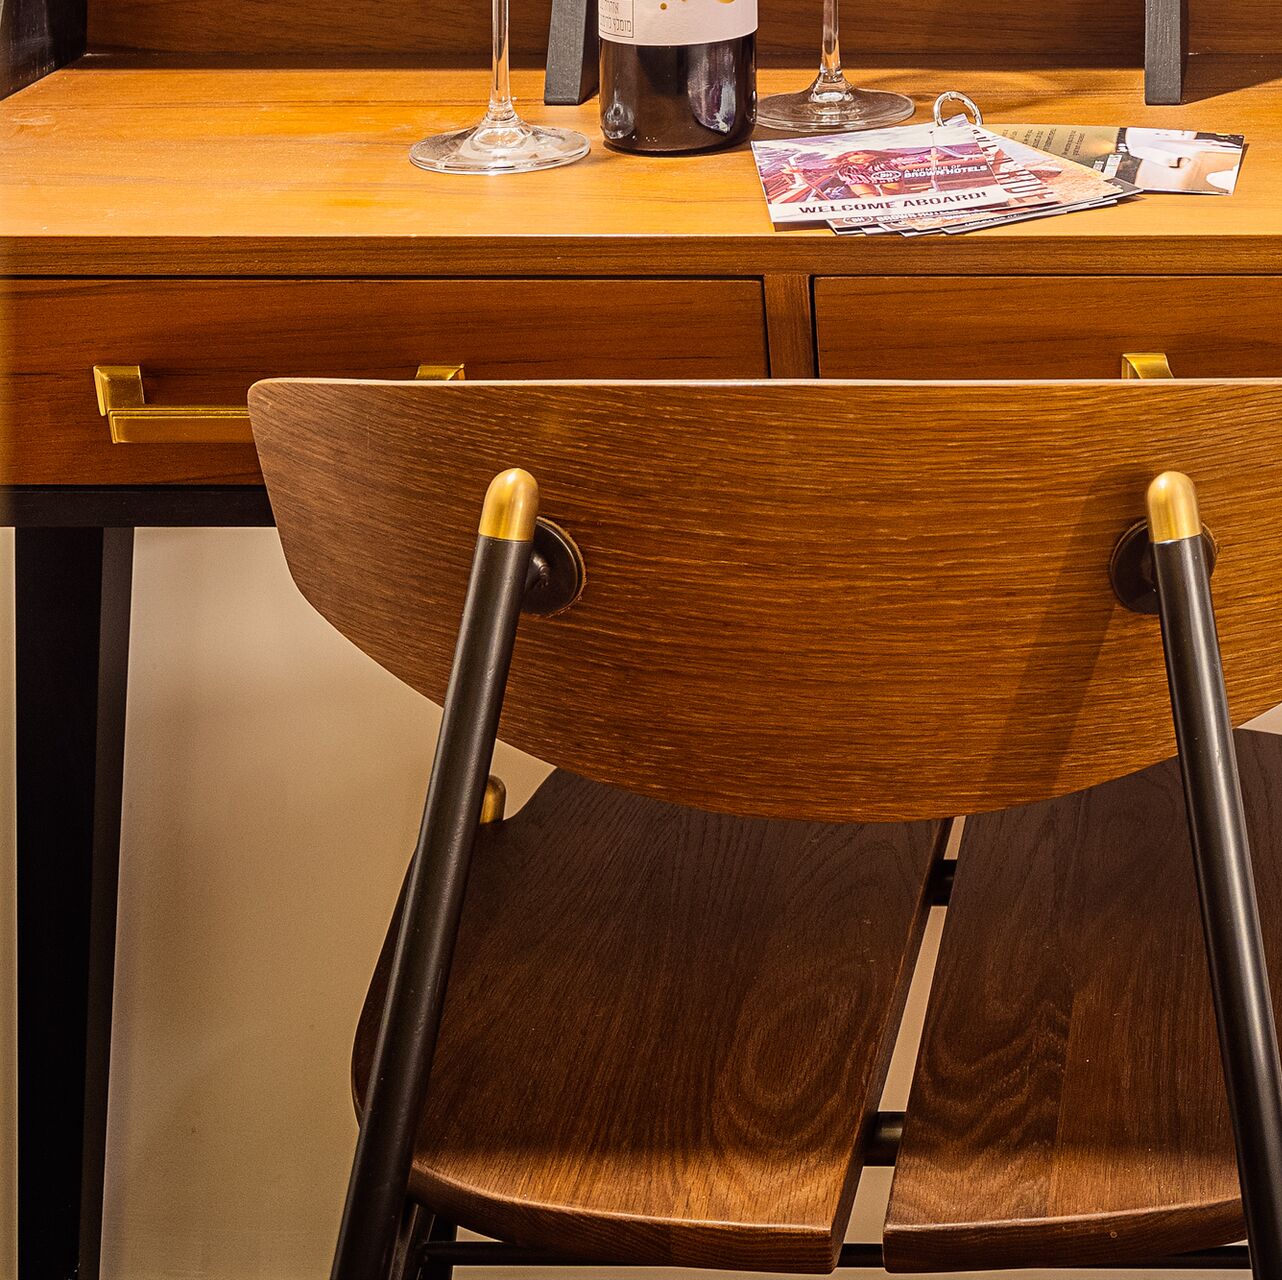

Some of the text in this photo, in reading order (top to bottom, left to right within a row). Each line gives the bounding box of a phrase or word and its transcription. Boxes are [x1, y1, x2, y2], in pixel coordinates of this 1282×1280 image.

[904, 165, 987, 179] BROWN HOTELS
[799, 191, 987, 213] WELCOME ABOARD!
